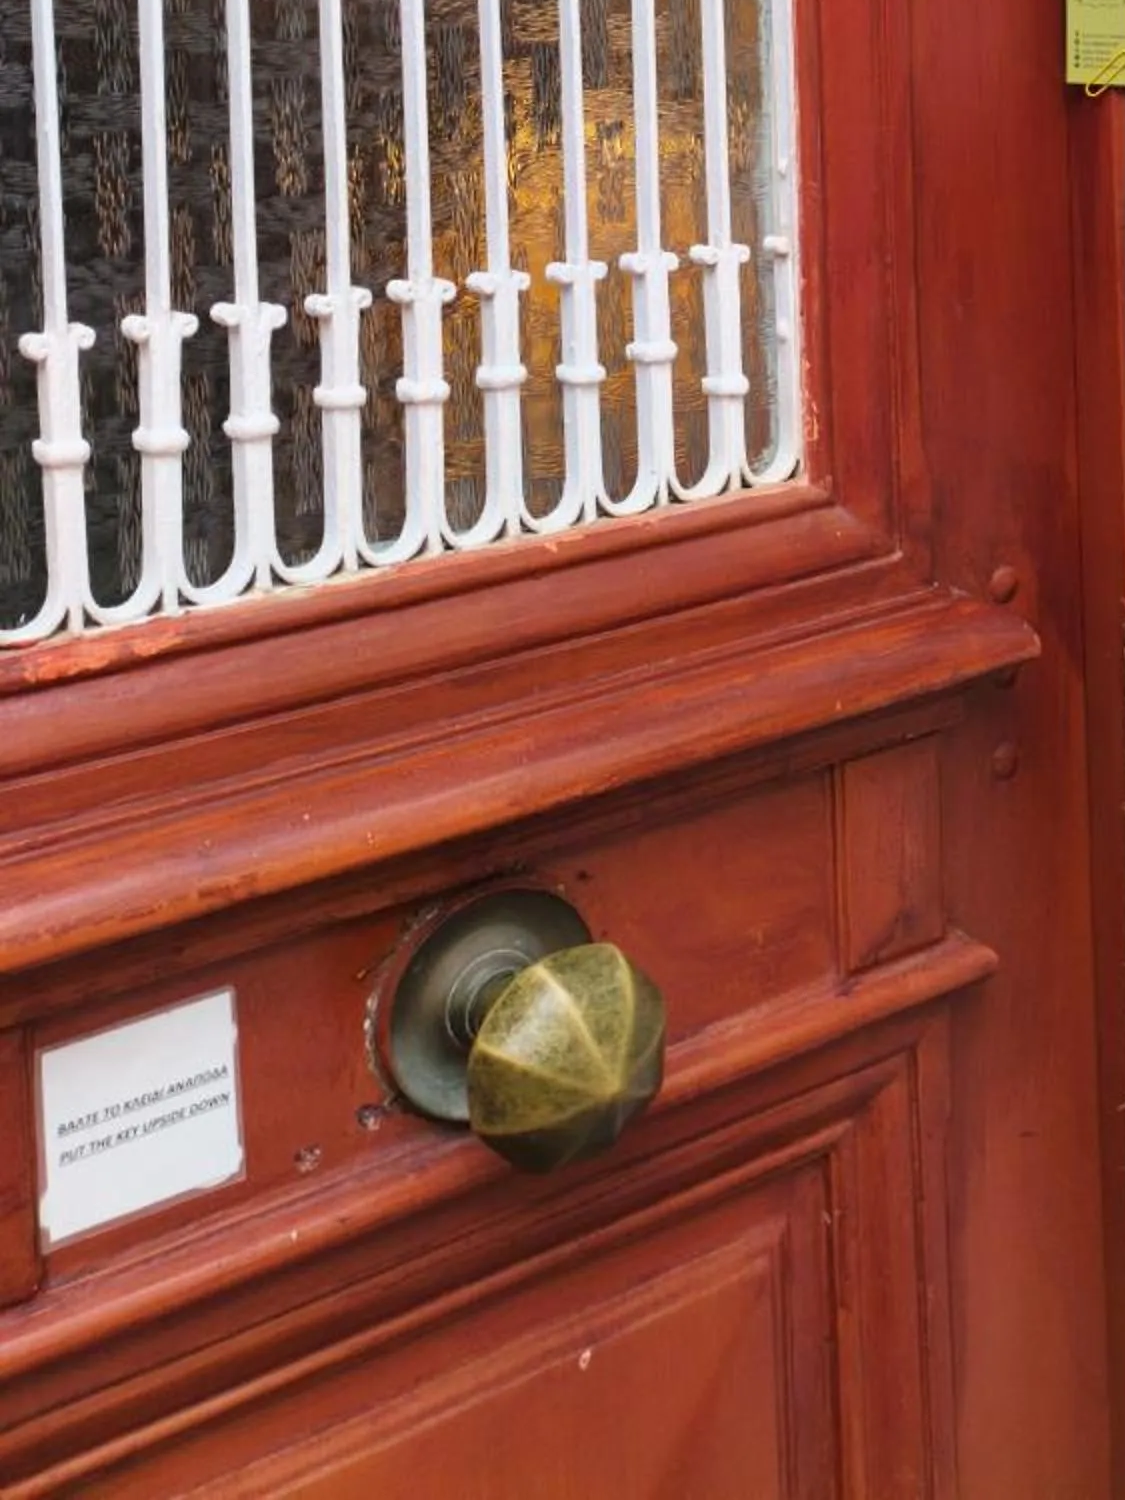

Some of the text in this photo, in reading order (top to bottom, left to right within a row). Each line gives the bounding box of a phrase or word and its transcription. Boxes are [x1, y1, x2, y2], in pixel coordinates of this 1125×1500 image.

[60, 1092, 230, 1166] PUT THE KEY UPSIDE DOWN
